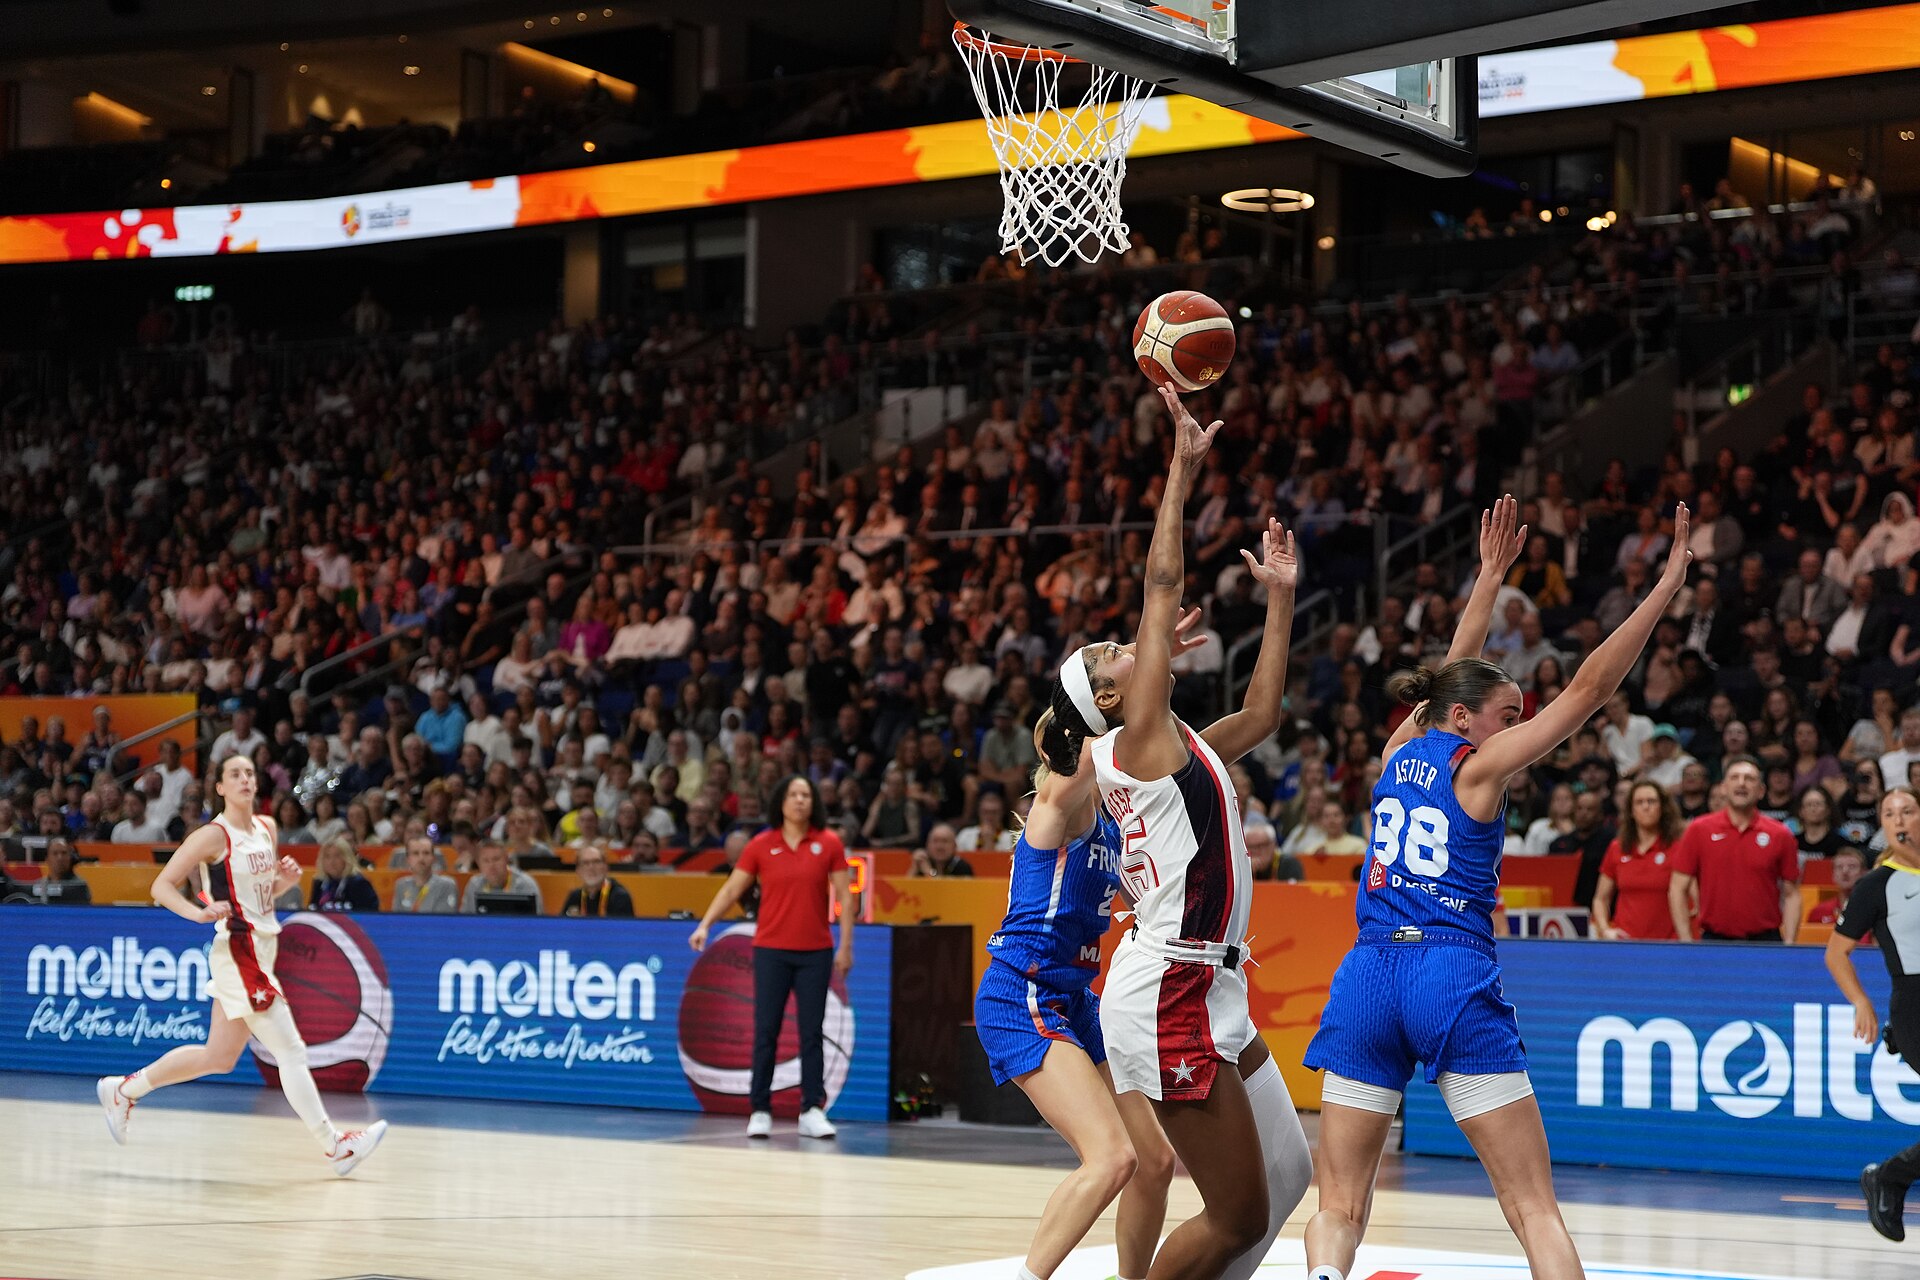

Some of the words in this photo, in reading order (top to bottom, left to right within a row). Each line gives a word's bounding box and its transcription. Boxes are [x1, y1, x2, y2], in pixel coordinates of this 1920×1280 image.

[1395, 759, 1438, 791] ASTIER
[1373, 797, 1449, 877] 98
[253, 880, 273, 916] 12
[26, 936, 209, 1001] molten
[438, 949, 656, 1021] molten
[25, 996, 80, 1042] feel
[75, 1004, 116, 1040] the
[437, 1014, 500, 1064] feel
[495, 1023, 544, 1062] the
